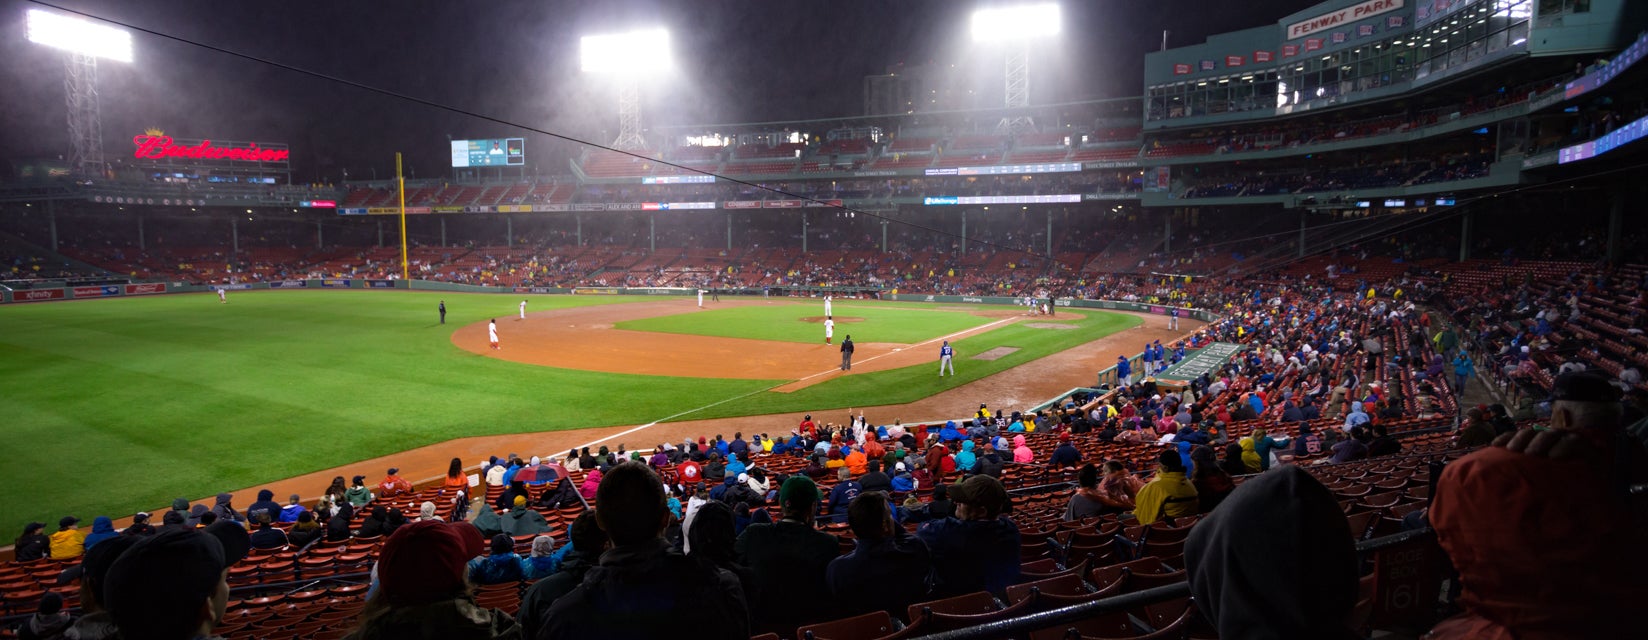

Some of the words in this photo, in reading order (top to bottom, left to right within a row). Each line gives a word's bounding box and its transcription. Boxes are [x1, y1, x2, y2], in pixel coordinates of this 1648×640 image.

[1293, 12, 1346, 35] FENWAY
[1354, 0, 1394, 17] PARK
[133, 135, 289, 161] Budweiser
[26, 291, 52, 299] xfinity
[1385, 582, 1420, 612] 161
